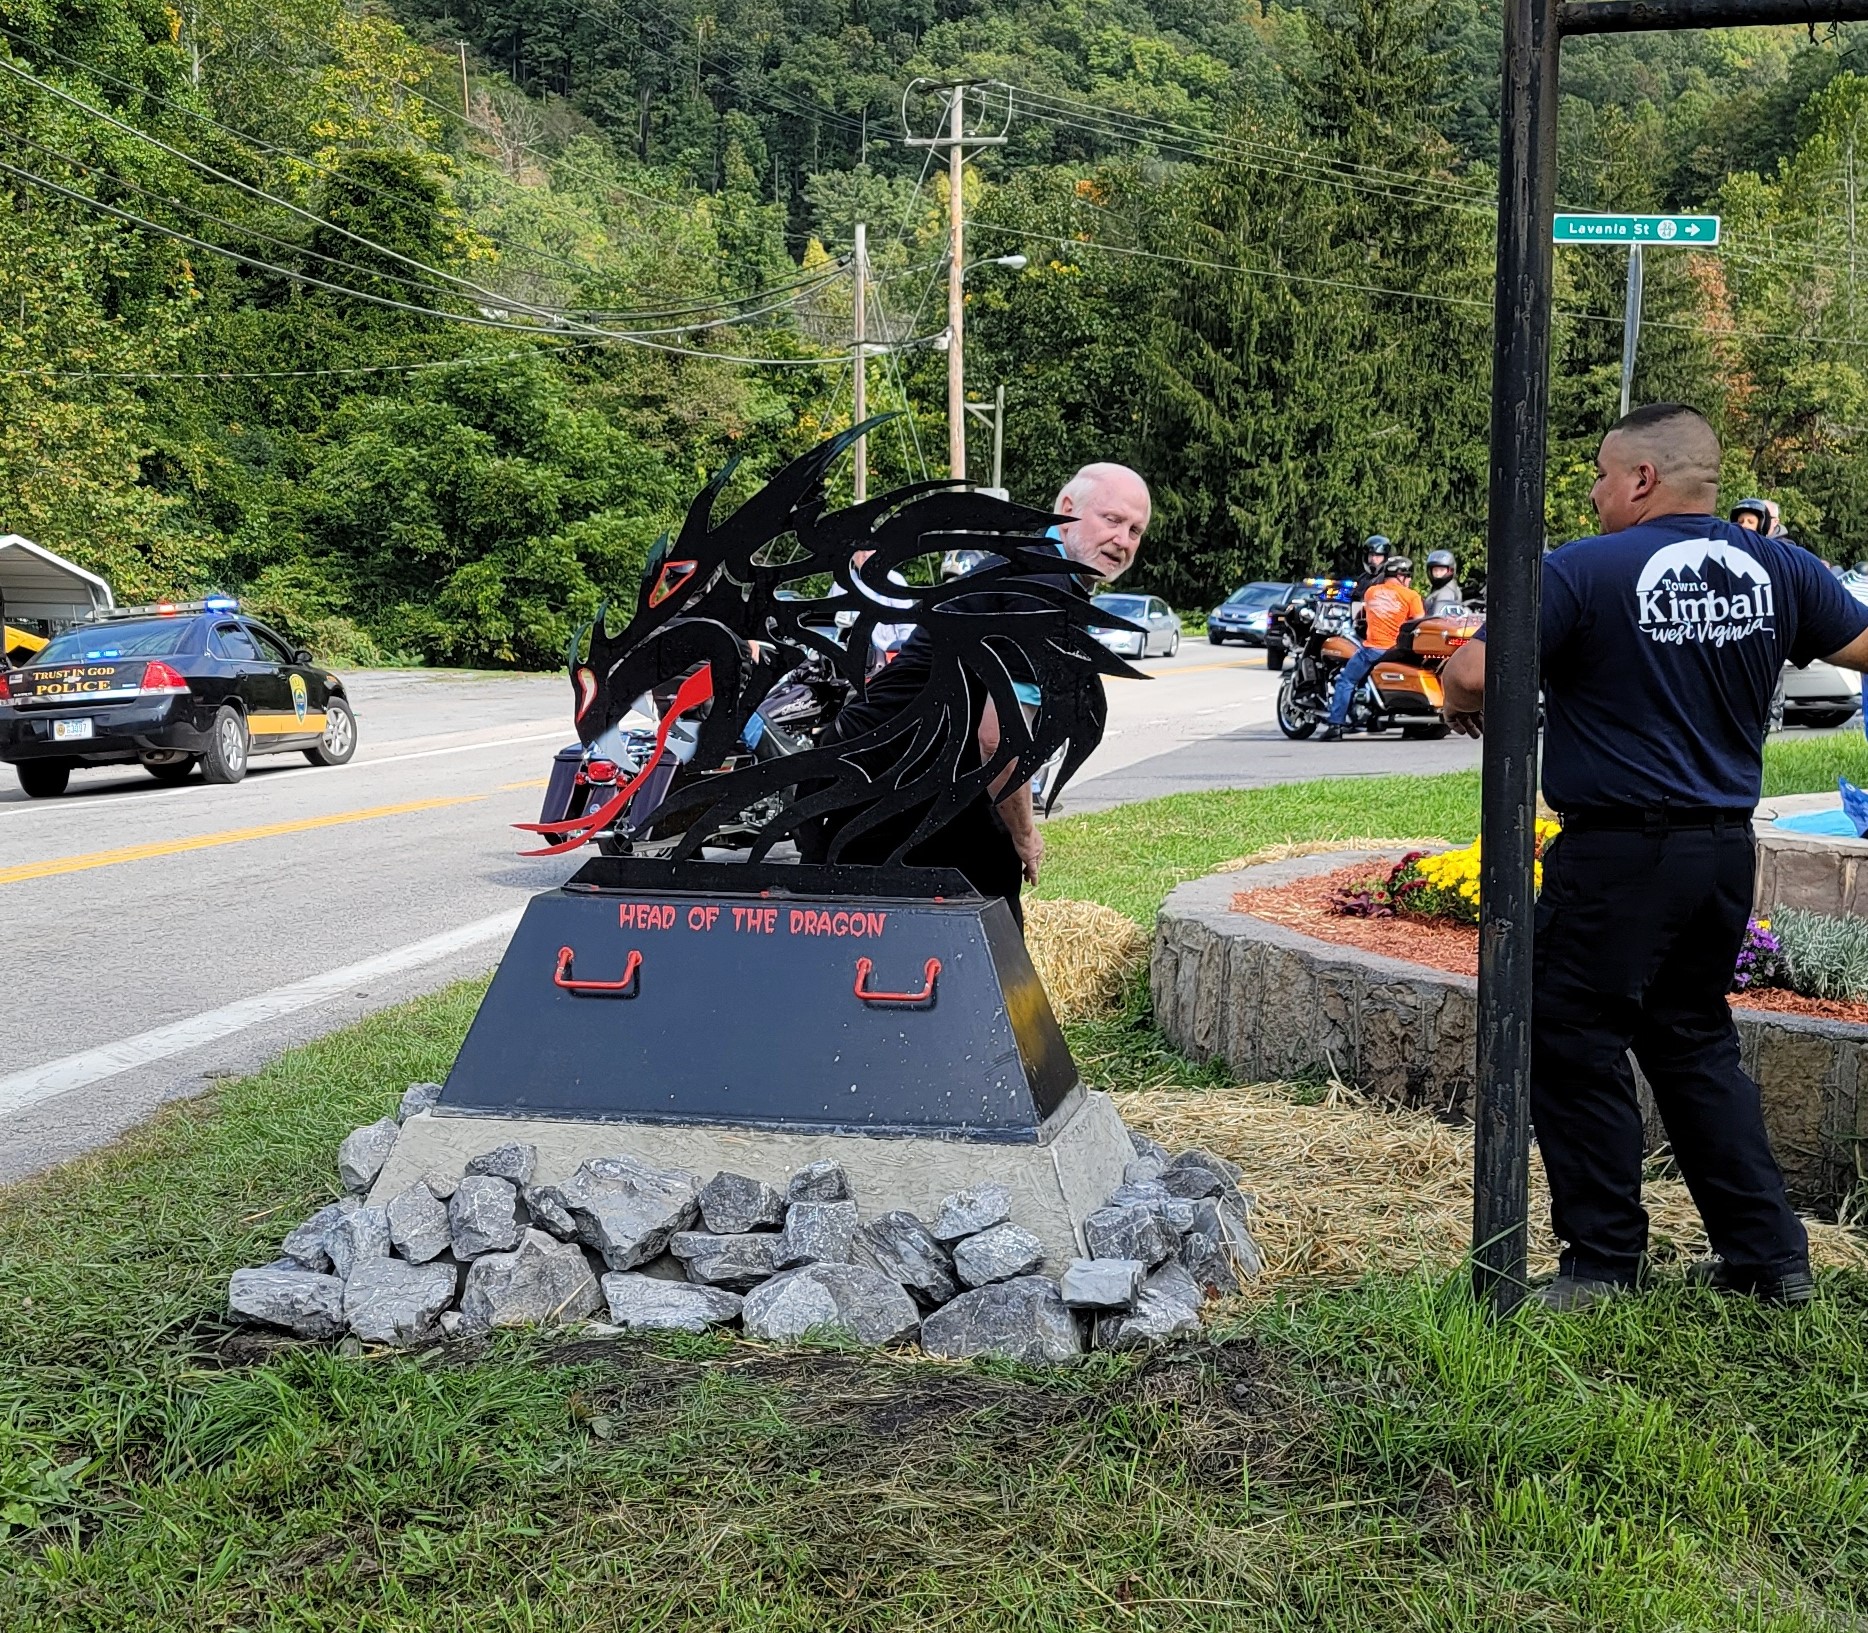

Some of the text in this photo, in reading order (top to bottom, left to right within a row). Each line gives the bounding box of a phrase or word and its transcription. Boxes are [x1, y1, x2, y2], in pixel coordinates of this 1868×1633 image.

[1569, 223, 1650, 235] Lavania St
[1662, 578, 1708, 592] Town o
[1636, 584, 1775, 625] Kimball
[33, 667, 115, 681] TRUST IN GOD
[36, 680, 111, 696] POLICE
[619, 903, 887, 938] HEAD OF THE DRAGON
